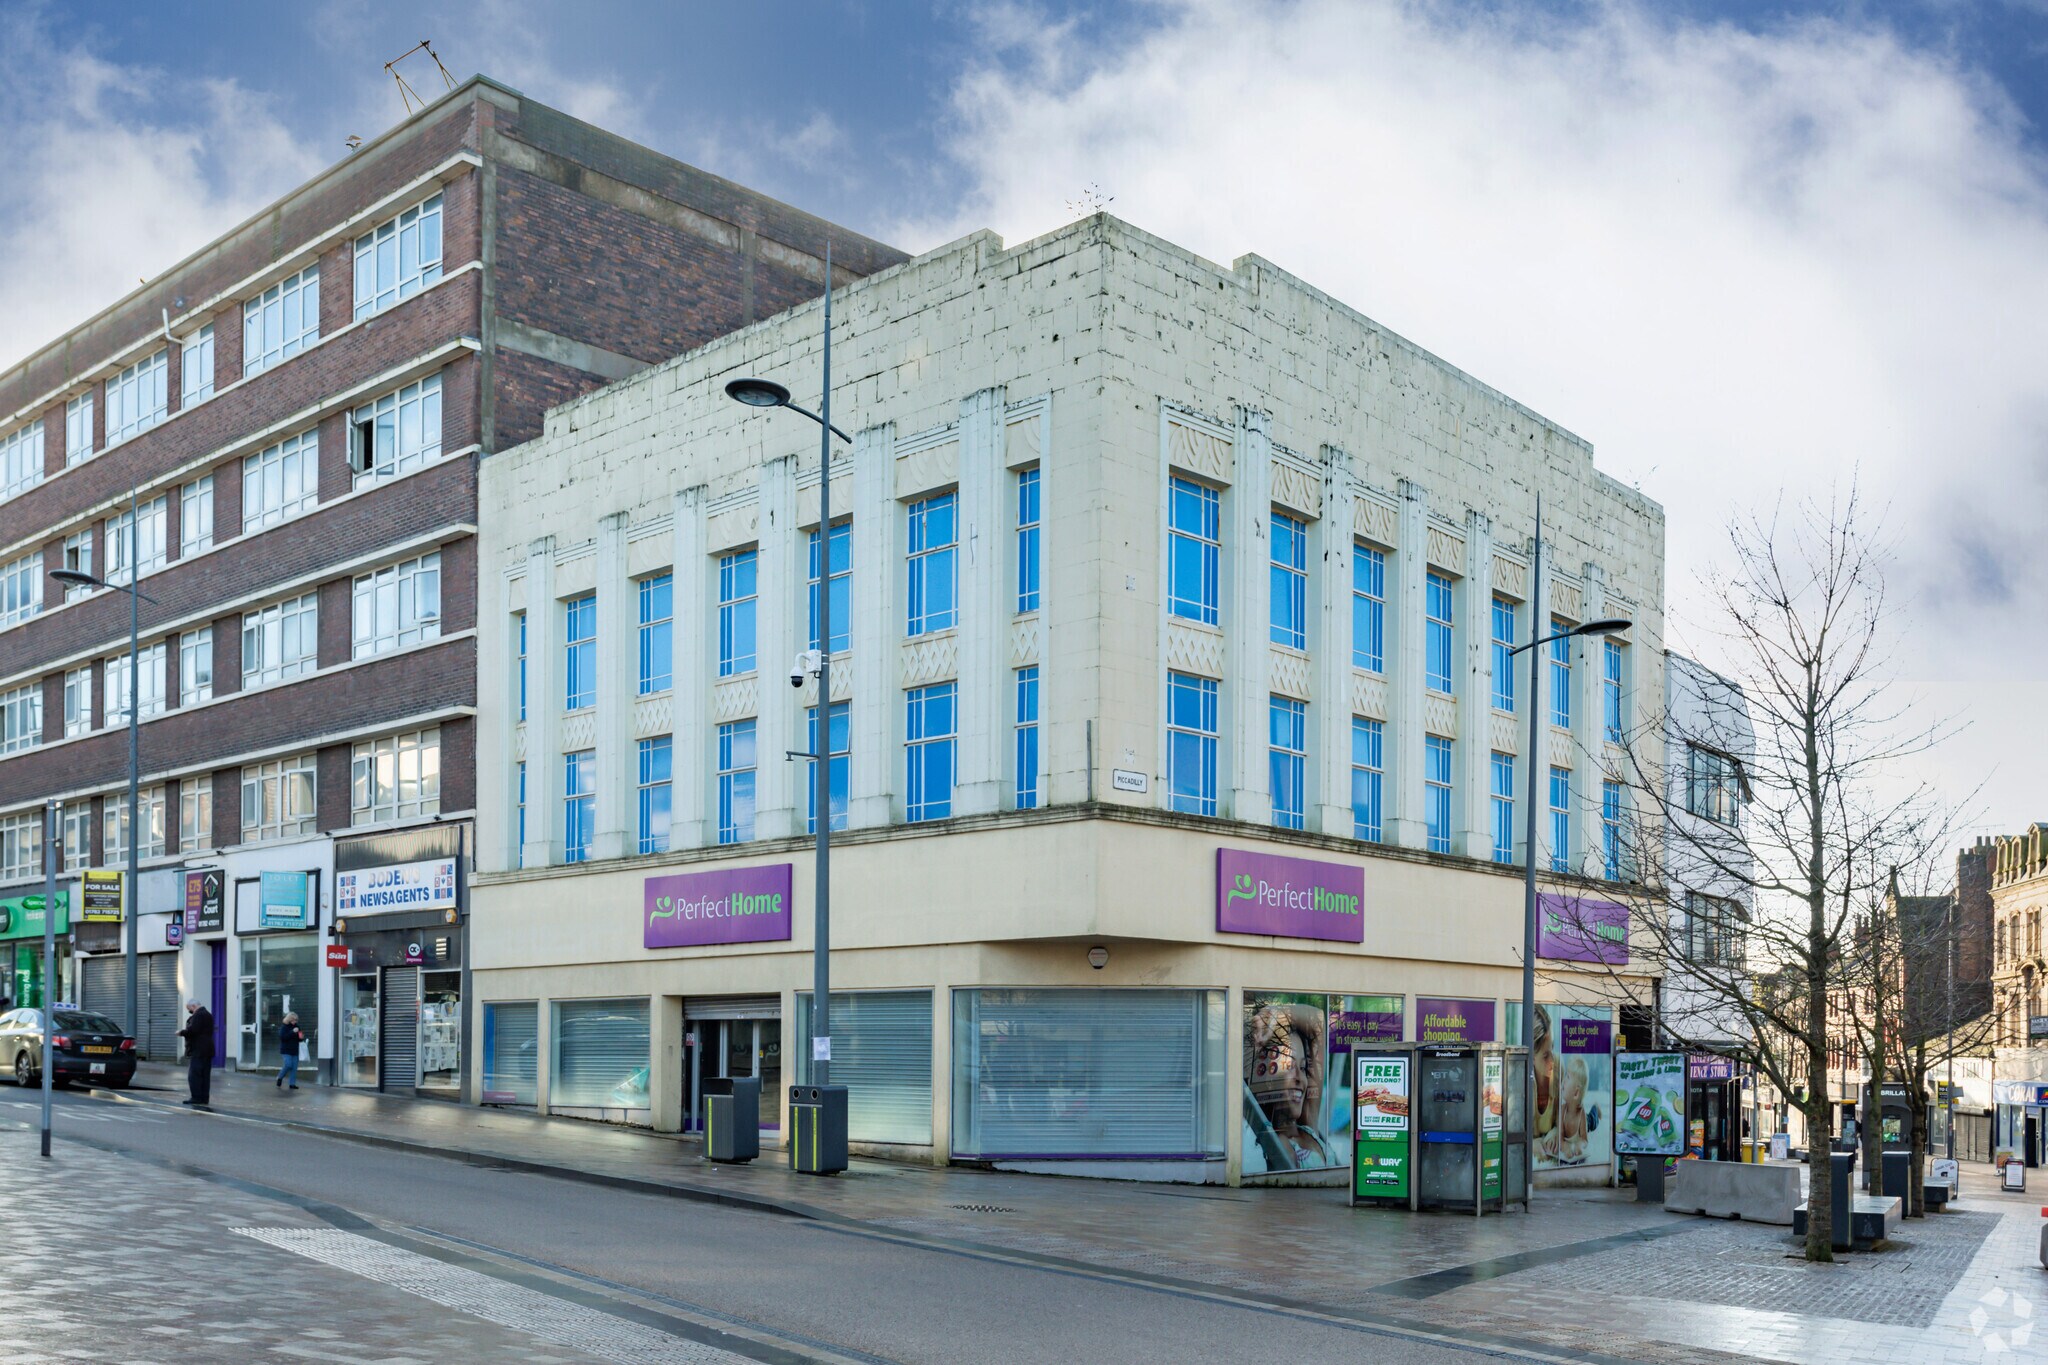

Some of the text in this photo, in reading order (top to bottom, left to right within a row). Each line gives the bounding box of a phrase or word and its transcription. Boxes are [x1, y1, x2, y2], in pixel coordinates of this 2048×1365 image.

[1117, 775, 1143, 787] PICCADILLY
[368, 867, 421, 888] BODEN'S
[360, 886, 430, 907] NEWSAGENTS
[1258, 880, 1359, 915] PerfectHome
[203, 905, 218, 915] Court
[677, 892, 782, 921] PerfectHome
[1423, 1014, 1467, 1028] Affordable
[1569, 1026, 1577, 1037] got
[1577, 1025, 1585, 1035] the
[1586, 1025, 1599, 1035] credit
[1336, 1033, 1343, 1045] in
[1365, 1065, 1401, 1077] FREE
[1486, 1065, 1500, 1077] FREE
[1620, 1060, 1648, 1071] TASTY
[1620, 1072, 1629, 1080] OF
[1710, 1066, 1728, 1078] STORE
[2009, 1086, 2036, 1103] CORAL
[1381, 1116, 1402, 1124] FREE
